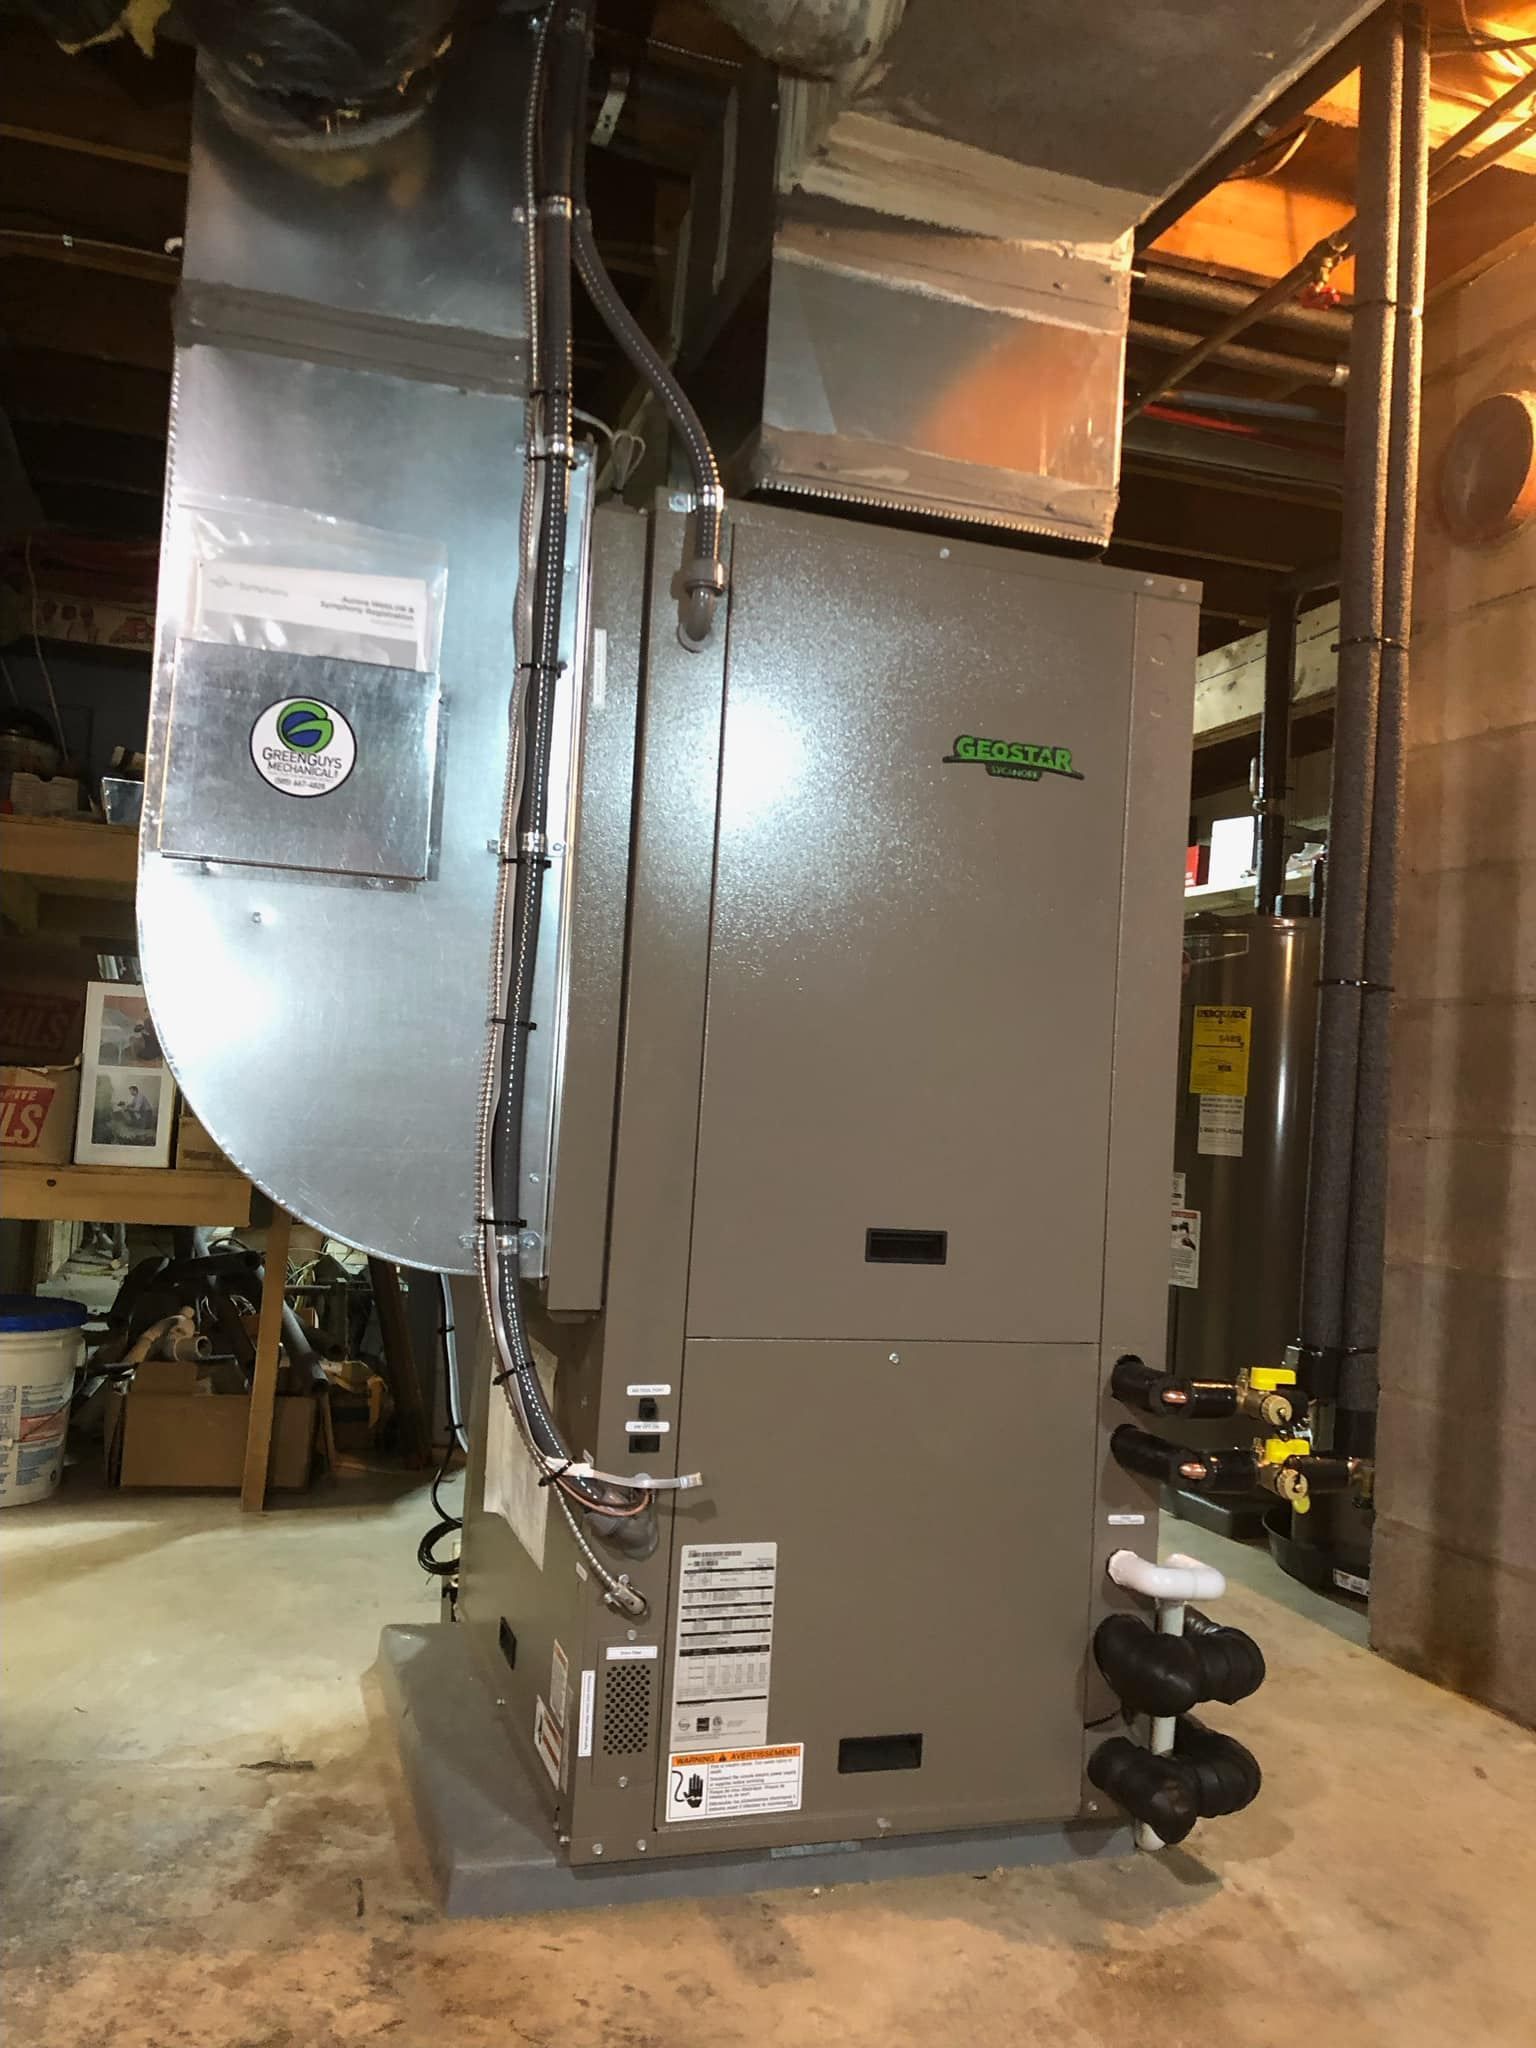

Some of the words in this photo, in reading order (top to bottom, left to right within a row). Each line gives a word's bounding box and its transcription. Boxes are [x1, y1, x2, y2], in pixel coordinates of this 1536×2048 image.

[262, 746, 342, 769] GREENGUYS
[953, 734, 1073, 772] GEOSTAR
[675, 1754, 715, 1765] WARNING
